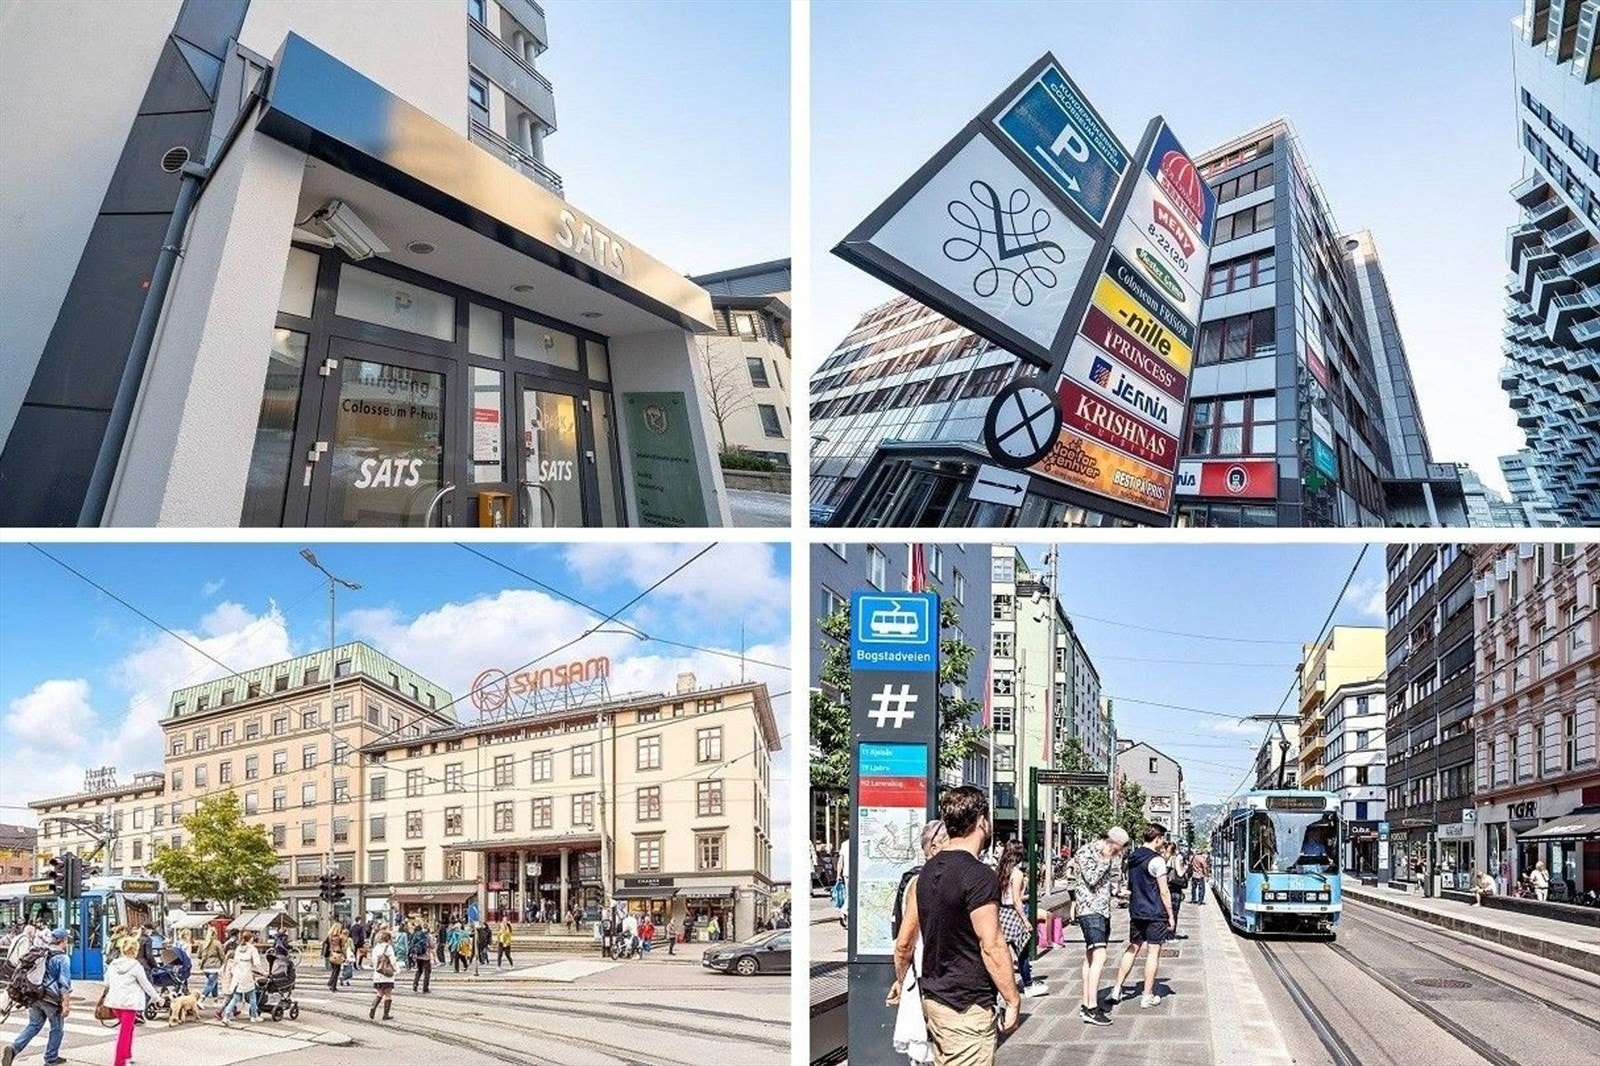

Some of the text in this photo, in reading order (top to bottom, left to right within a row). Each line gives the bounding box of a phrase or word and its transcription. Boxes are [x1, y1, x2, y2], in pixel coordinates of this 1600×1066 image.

[1050, 123, 1090, 163] P
[555, 209, 625, 275] SATS
[1158, 207, 1191, 249] MENY
[1148, 223, 1189, 273] 8-22(20)
[342, 399, 438, 420] Colosseum P-hus
[1074, 394, 1167, 457] KRISHNAS
[354, 458, 423, 489] SATS
[539, 460, 573, 482] SATS
[856, 650, 931, 662] Bogstadveien
[1507, 801, 1536, 819] TGR
